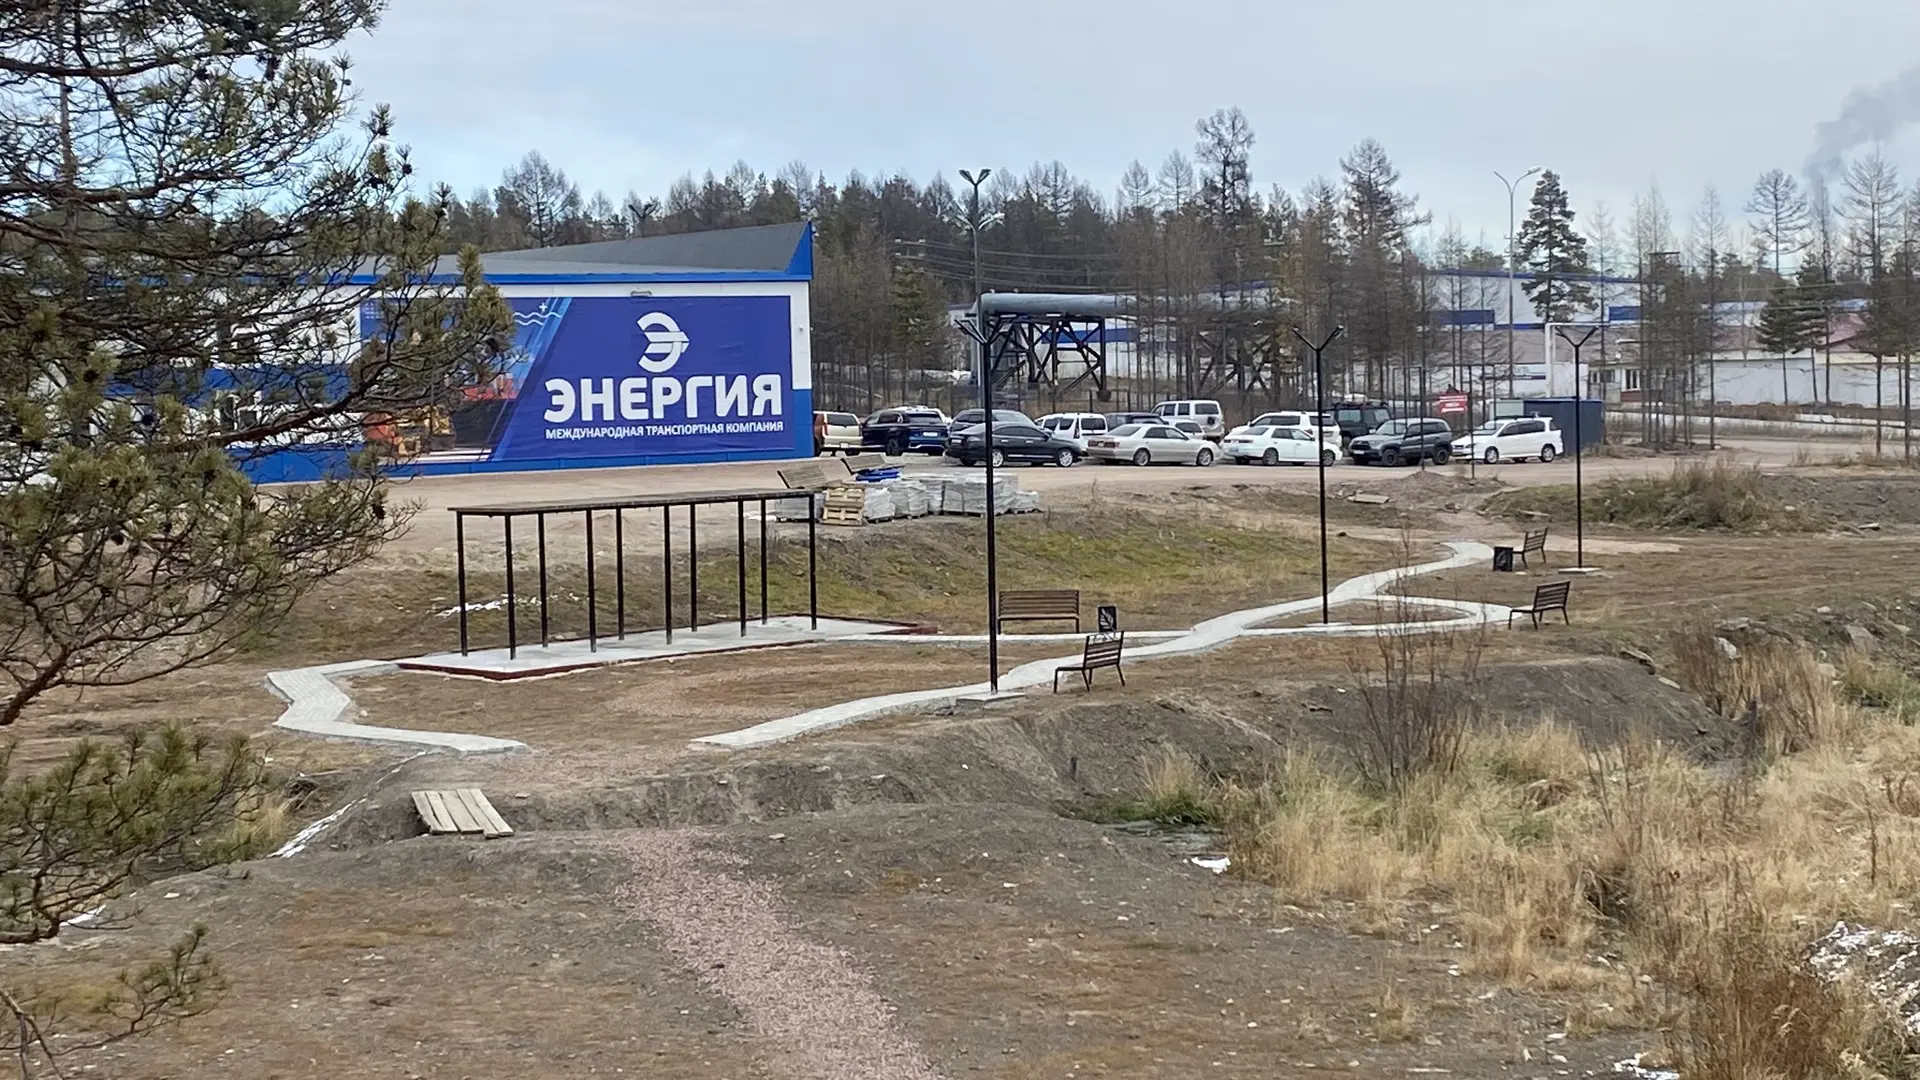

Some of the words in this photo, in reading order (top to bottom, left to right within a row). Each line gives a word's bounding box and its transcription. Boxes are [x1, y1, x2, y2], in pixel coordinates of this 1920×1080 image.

[543, 374, 782, 422] ЭНЕРГИЯ
[545, 425, 644, 440] МЕЖДУНАРОДНАЯ
[645, 422, 724, 436] ТРАНСПОРТНАЯ
[725, 420, 784, 433] КОМПАНИЯ
